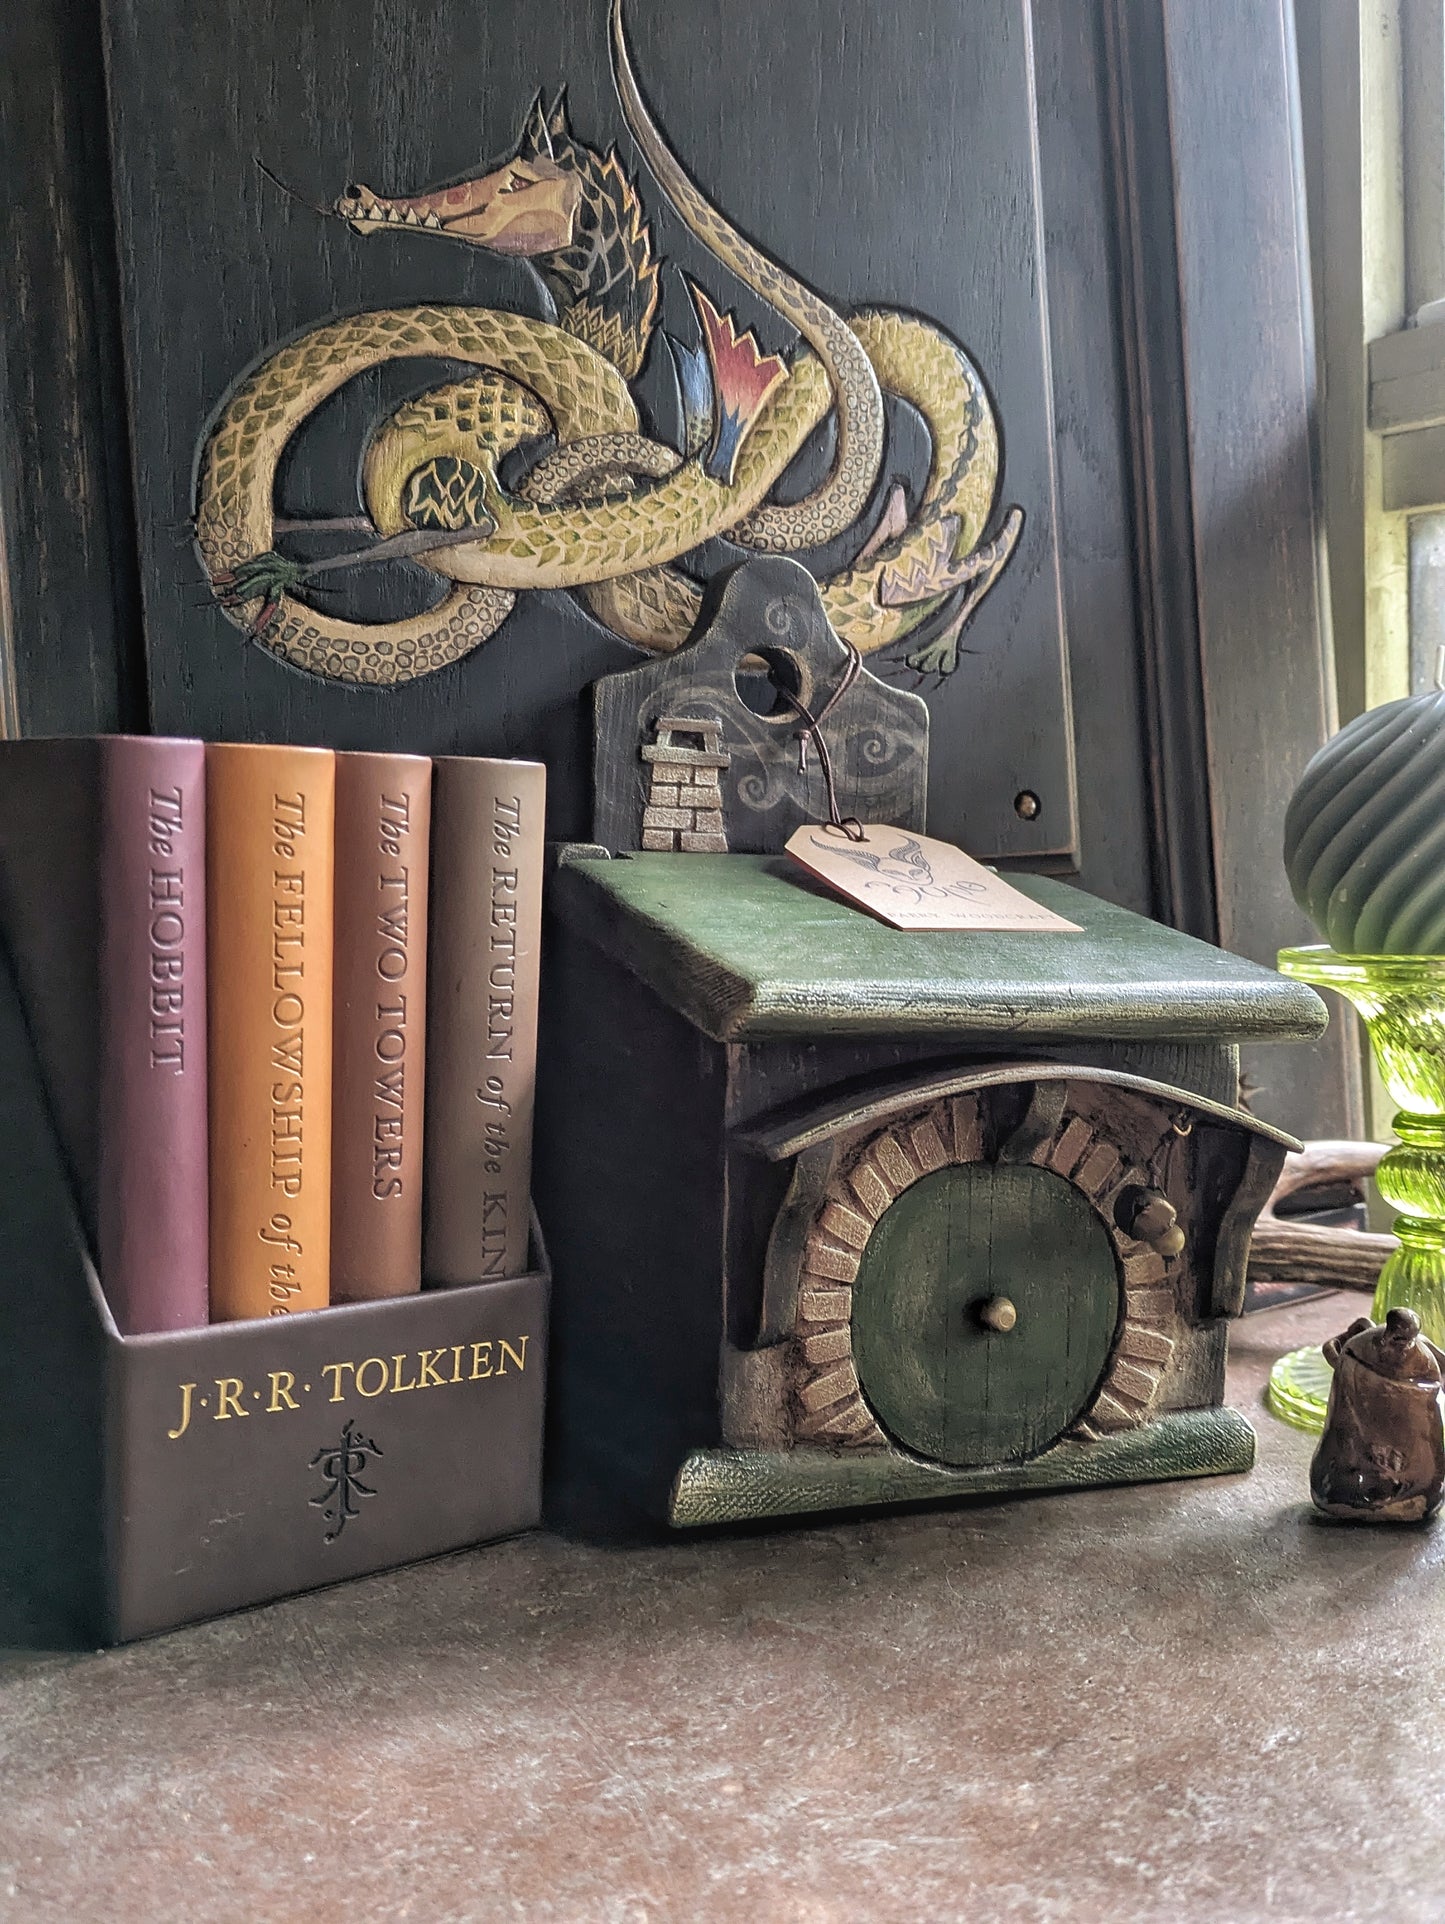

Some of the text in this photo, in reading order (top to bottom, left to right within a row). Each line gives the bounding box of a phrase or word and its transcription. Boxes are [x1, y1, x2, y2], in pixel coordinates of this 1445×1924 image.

[272, 792, 306, 860] The
[492, 796, 521, 859] The
[149, 786, 185, 1077] The HOBBIT
[485, 867, 519, 1063] RETURN
[371, 792, 410, 1200] The TWO TOWERS
[270, 870, 306, 1198] FELLOWSHIP
[475, 1075, 512, 1118] of
[483, 1122, 511, 1174] the
[258, 1213, 303, 1257] of
